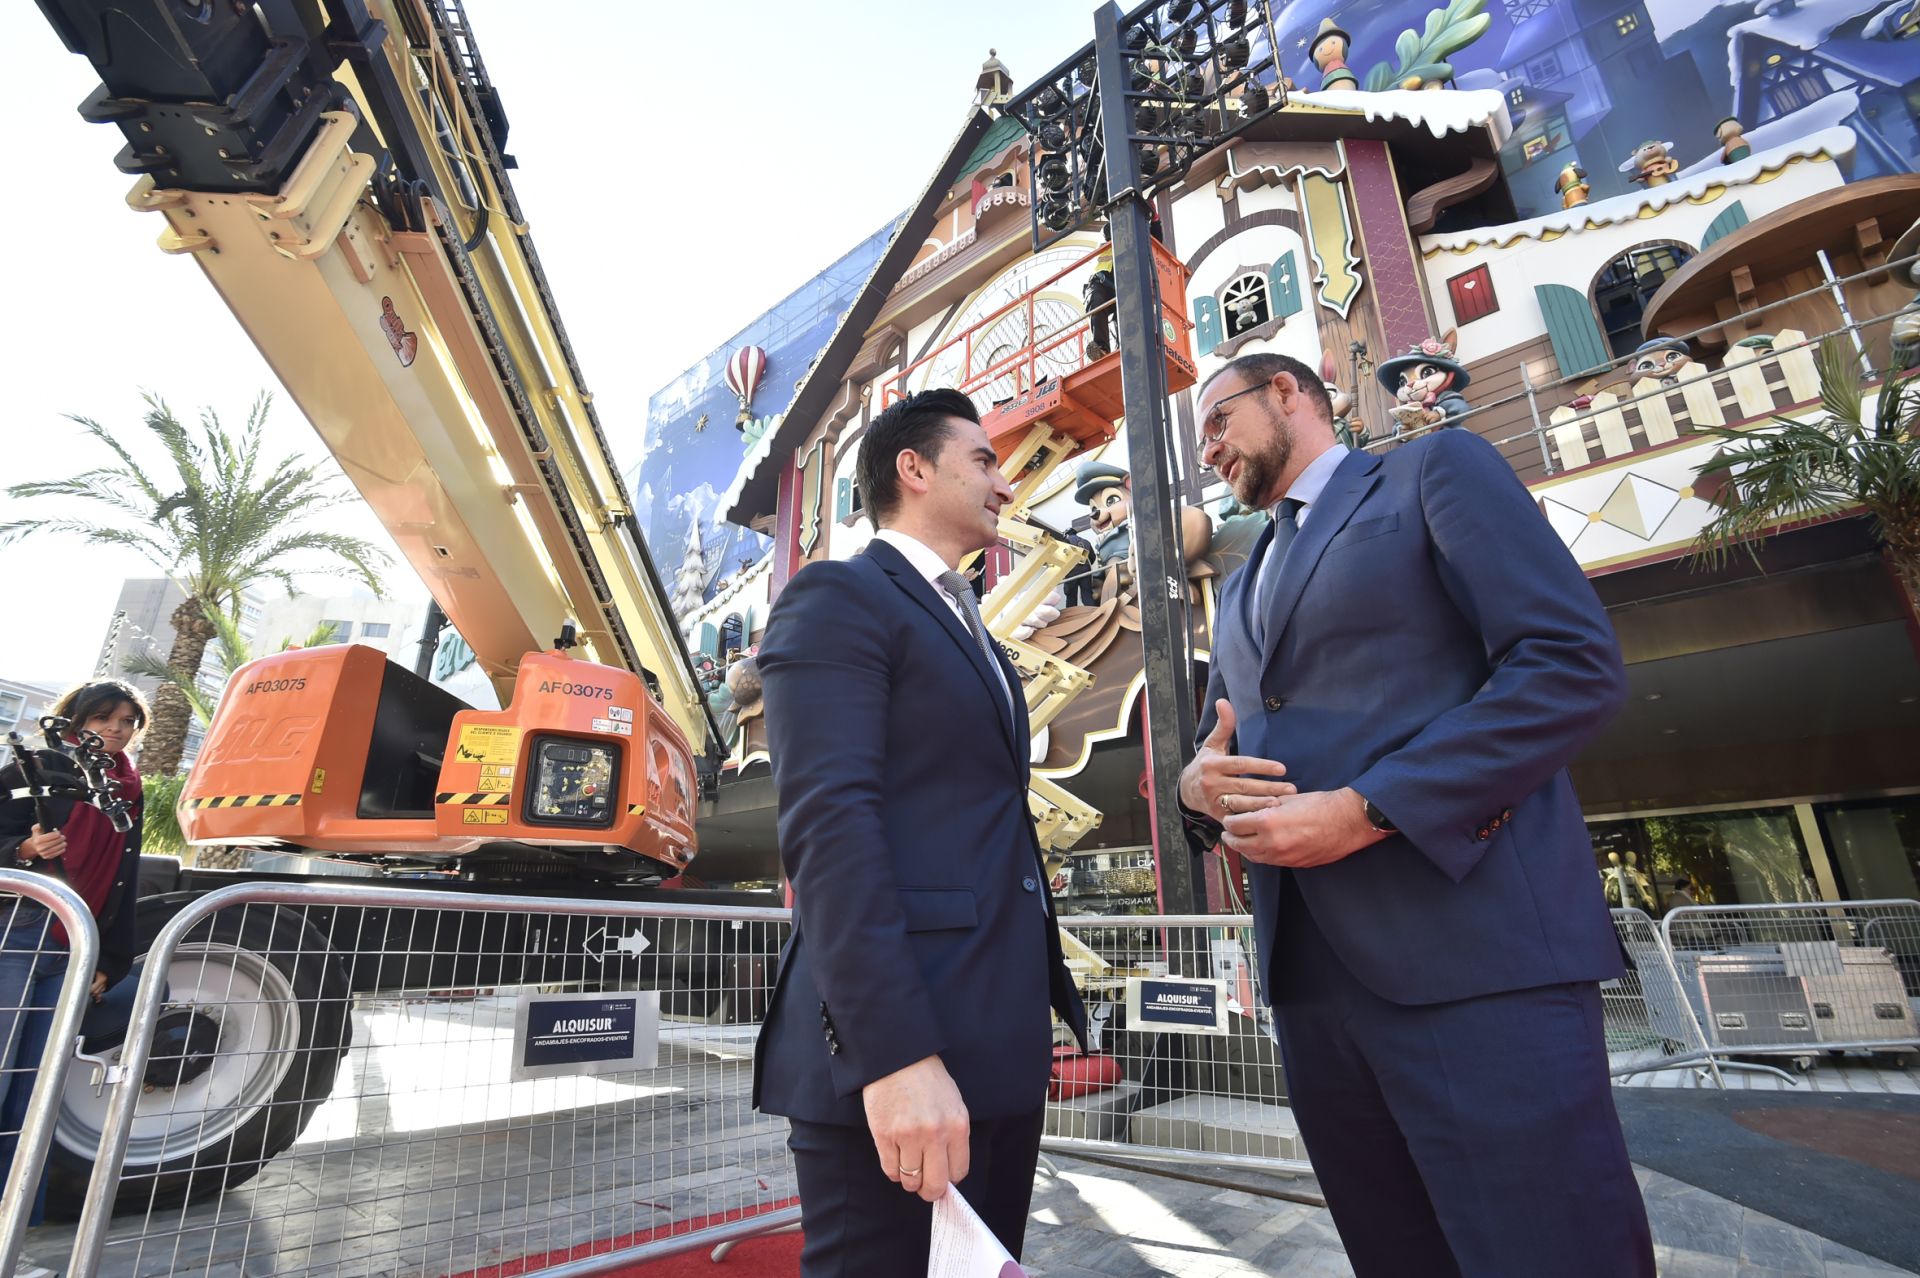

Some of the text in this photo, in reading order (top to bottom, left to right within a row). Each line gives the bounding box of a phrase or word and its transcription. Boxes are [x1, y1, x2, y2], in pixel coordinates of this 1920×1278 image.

[1035, 380, 1058, 400] JLG
[1024, 403, 1046, 418] 3908
[245, 678, 307, 695] AF03075
[538, 680, 614, 701] AF03075
[1157, 993, 1199, 1005] ALQUISUR
[552, 1017, 612, 1033] ALQUISUR
